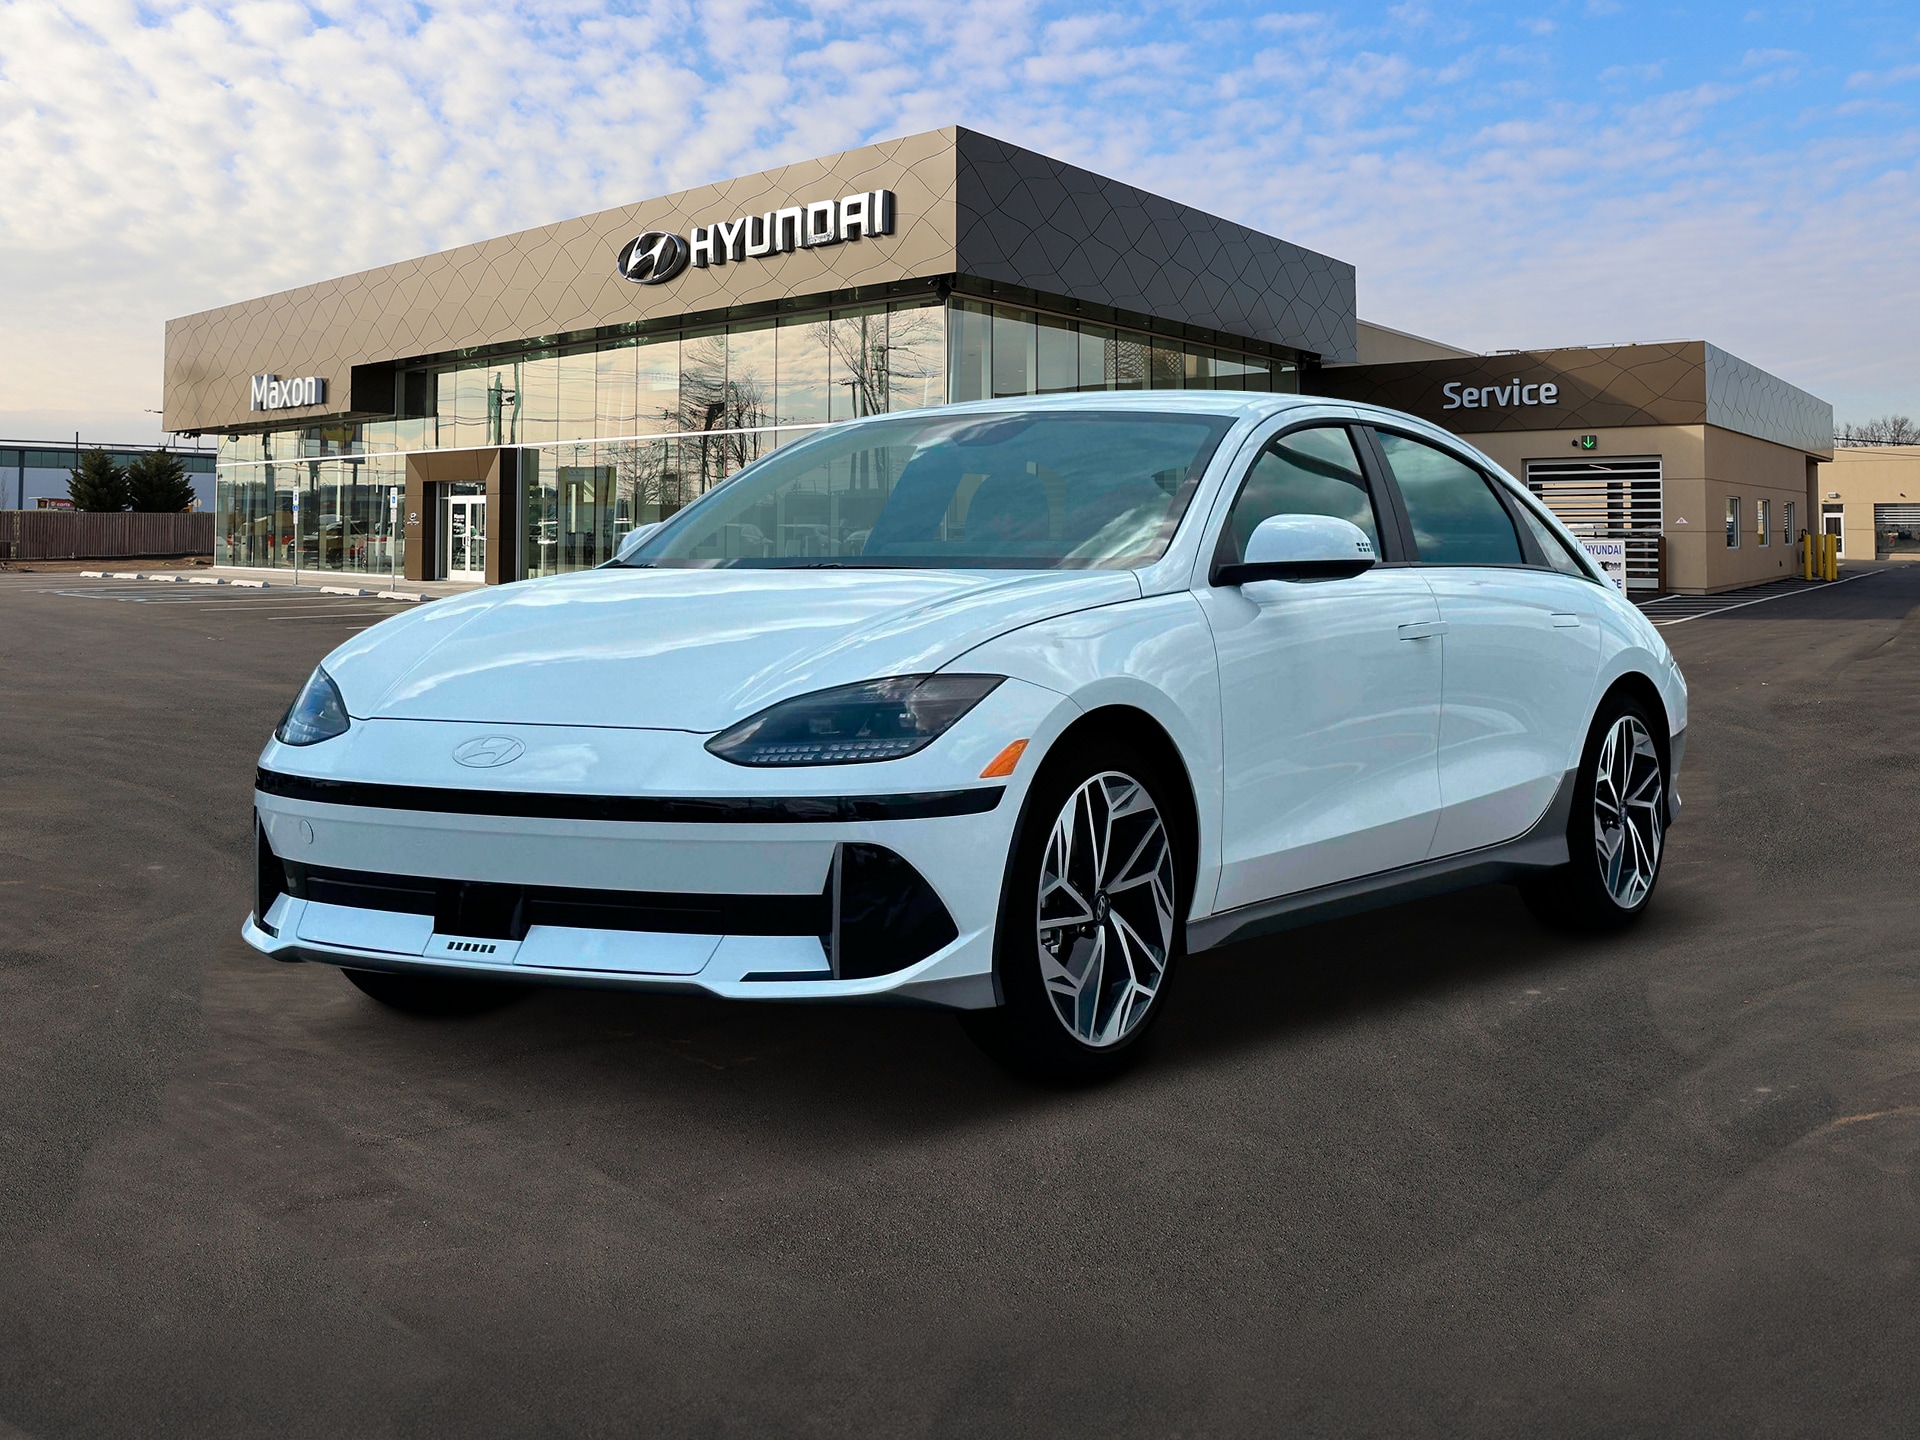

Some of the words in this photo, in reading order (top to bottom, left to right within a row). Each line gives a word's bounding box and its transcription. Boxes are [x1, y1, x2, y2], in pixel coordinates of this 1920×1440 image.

[690, 189, 894, 268] HYUNDAI
[250, 374, 323, 411] Maxon
[1443, 378, 1558, 409] Service
